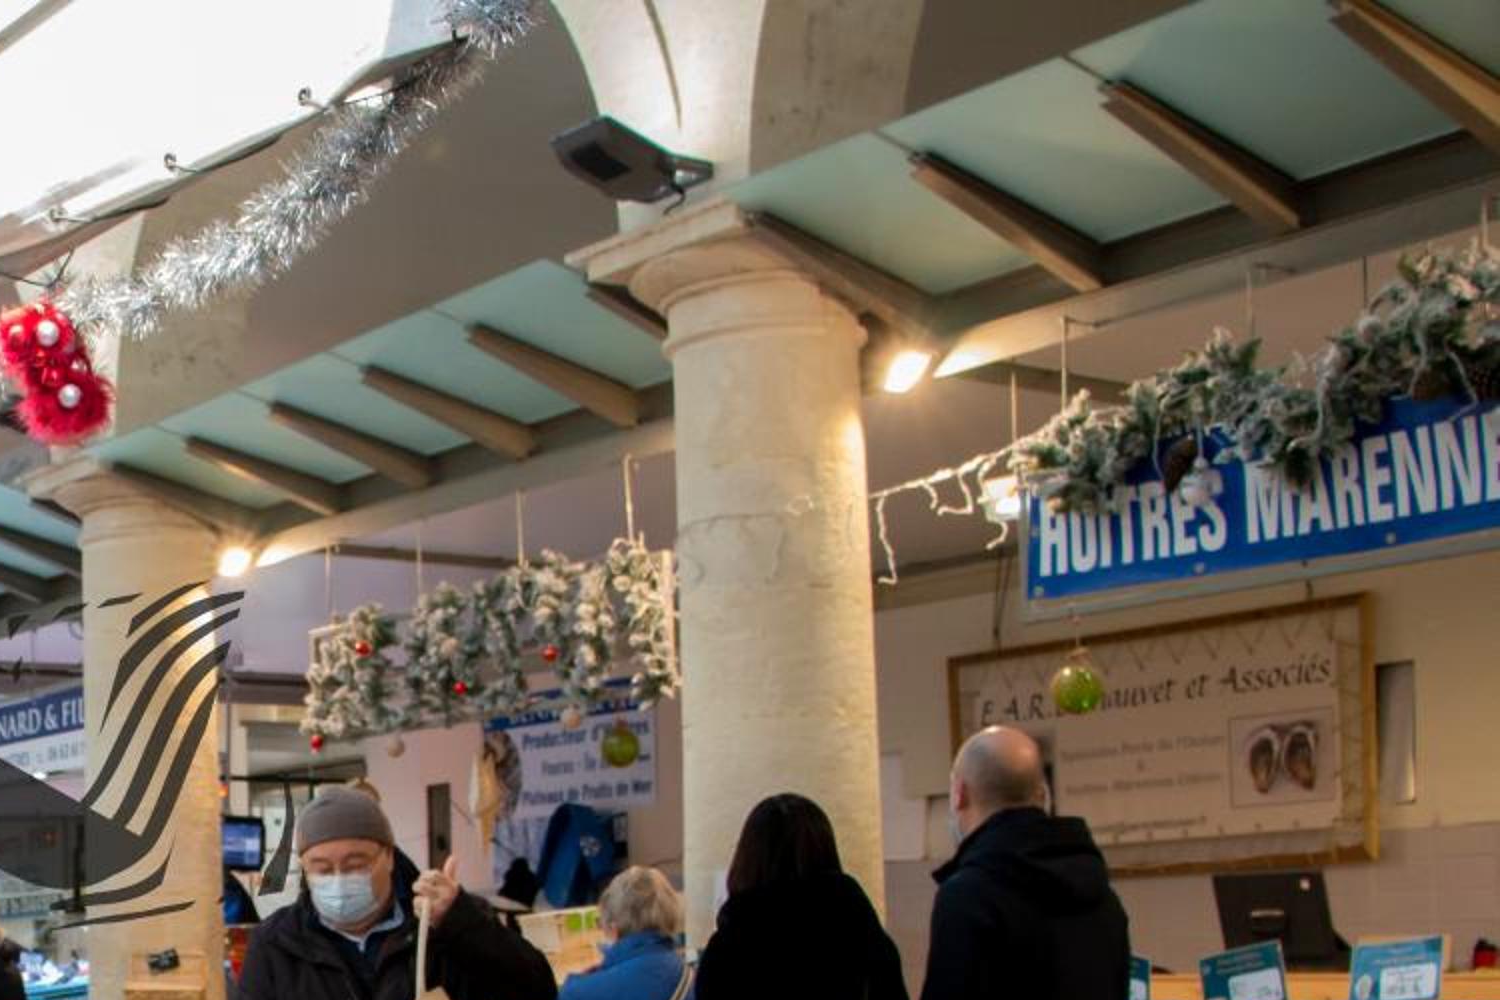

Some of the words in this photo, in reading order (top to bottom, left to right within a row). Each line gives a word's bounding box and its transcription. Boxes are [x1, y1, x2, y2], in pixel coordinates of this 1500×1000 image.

[1186, 673, 1210, 701] et
[1218, 653, 1334, 695] Associés
[43, 703, 59, 731] &
